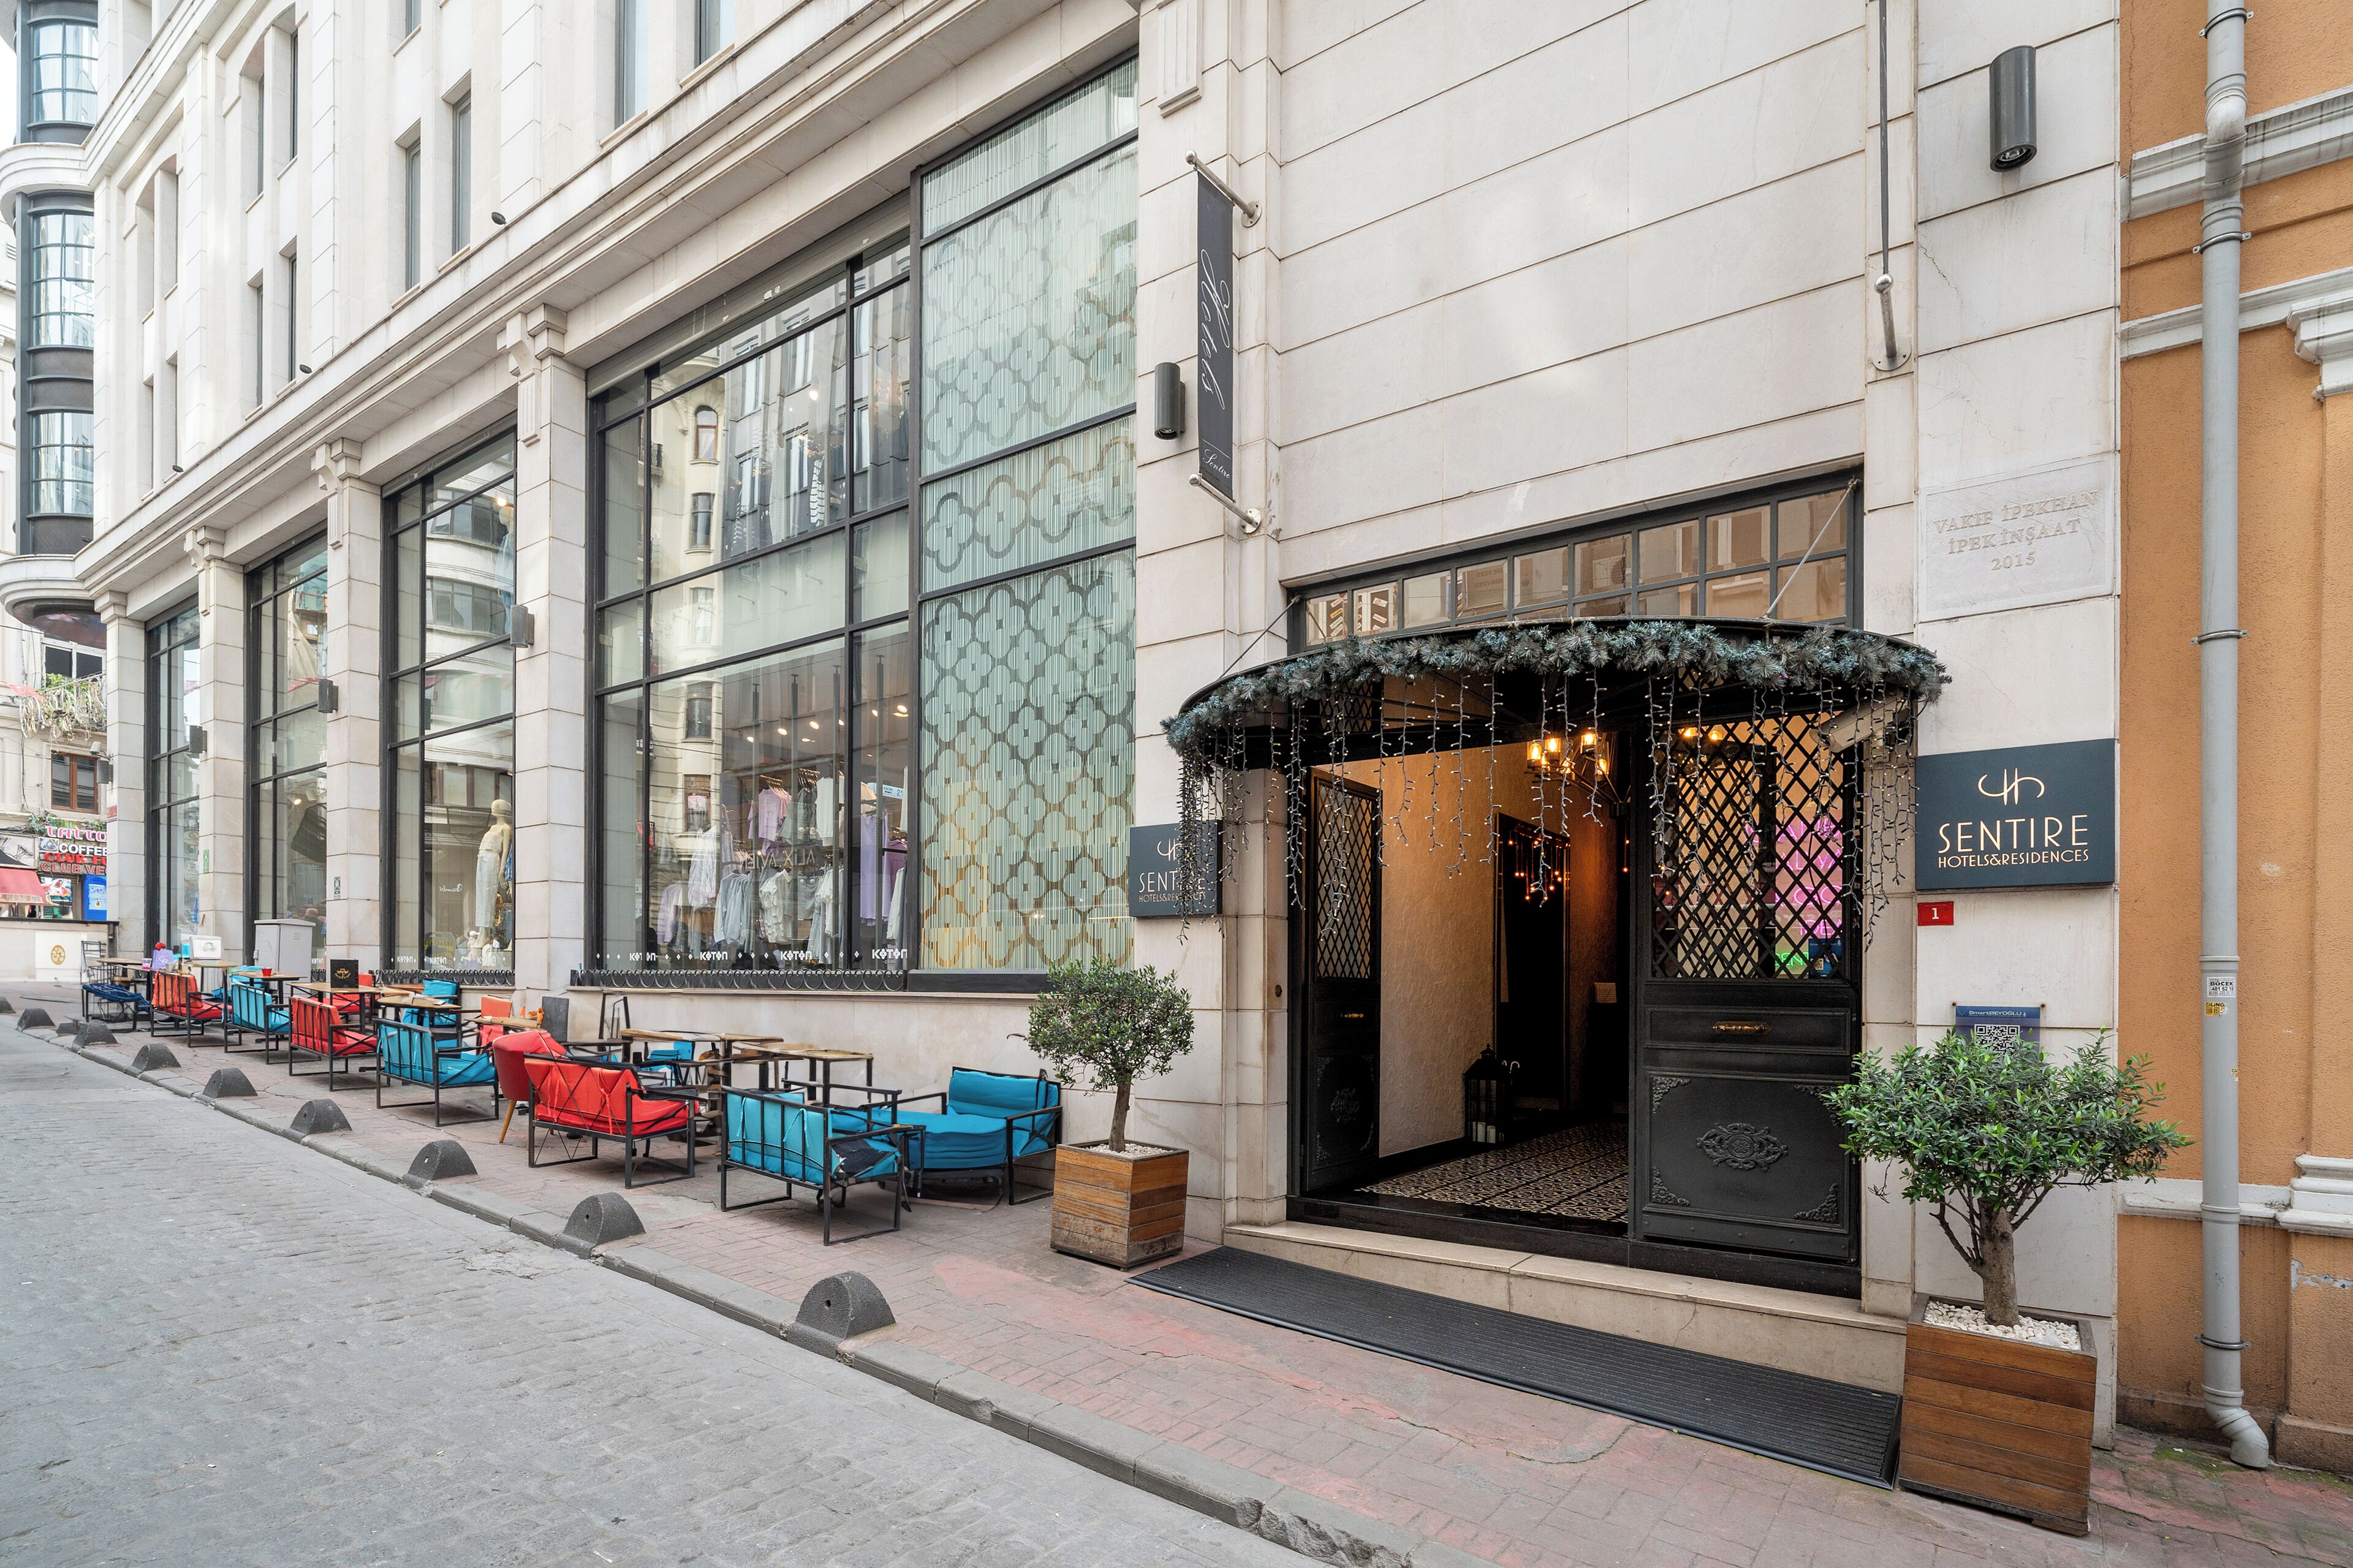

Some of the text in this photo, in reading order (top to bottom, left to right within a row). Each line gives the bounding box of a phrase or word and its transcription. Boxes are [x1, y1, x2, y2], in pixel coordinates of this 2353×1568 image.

[1202, 449, 1230, 479] Sentire
[1933, 510, 1993, 533] VAKIF
[1948, 518, 2080, 555] İPEK İNŞAAT
[1991, 550, 2036, 571] 2015
[1938, 814, 2088, 854] SENTIRE
[41, 862, 81, 873] CLUB
[44, 852, 85, 864] CLUB
[1938, 849, 2089, 868] HOTELS&RESIDENCES
[1931, 907, 1939, 920] 1
[700, 951, 728, 961] KOTON
[780, 950, 812, 961] KOTON
